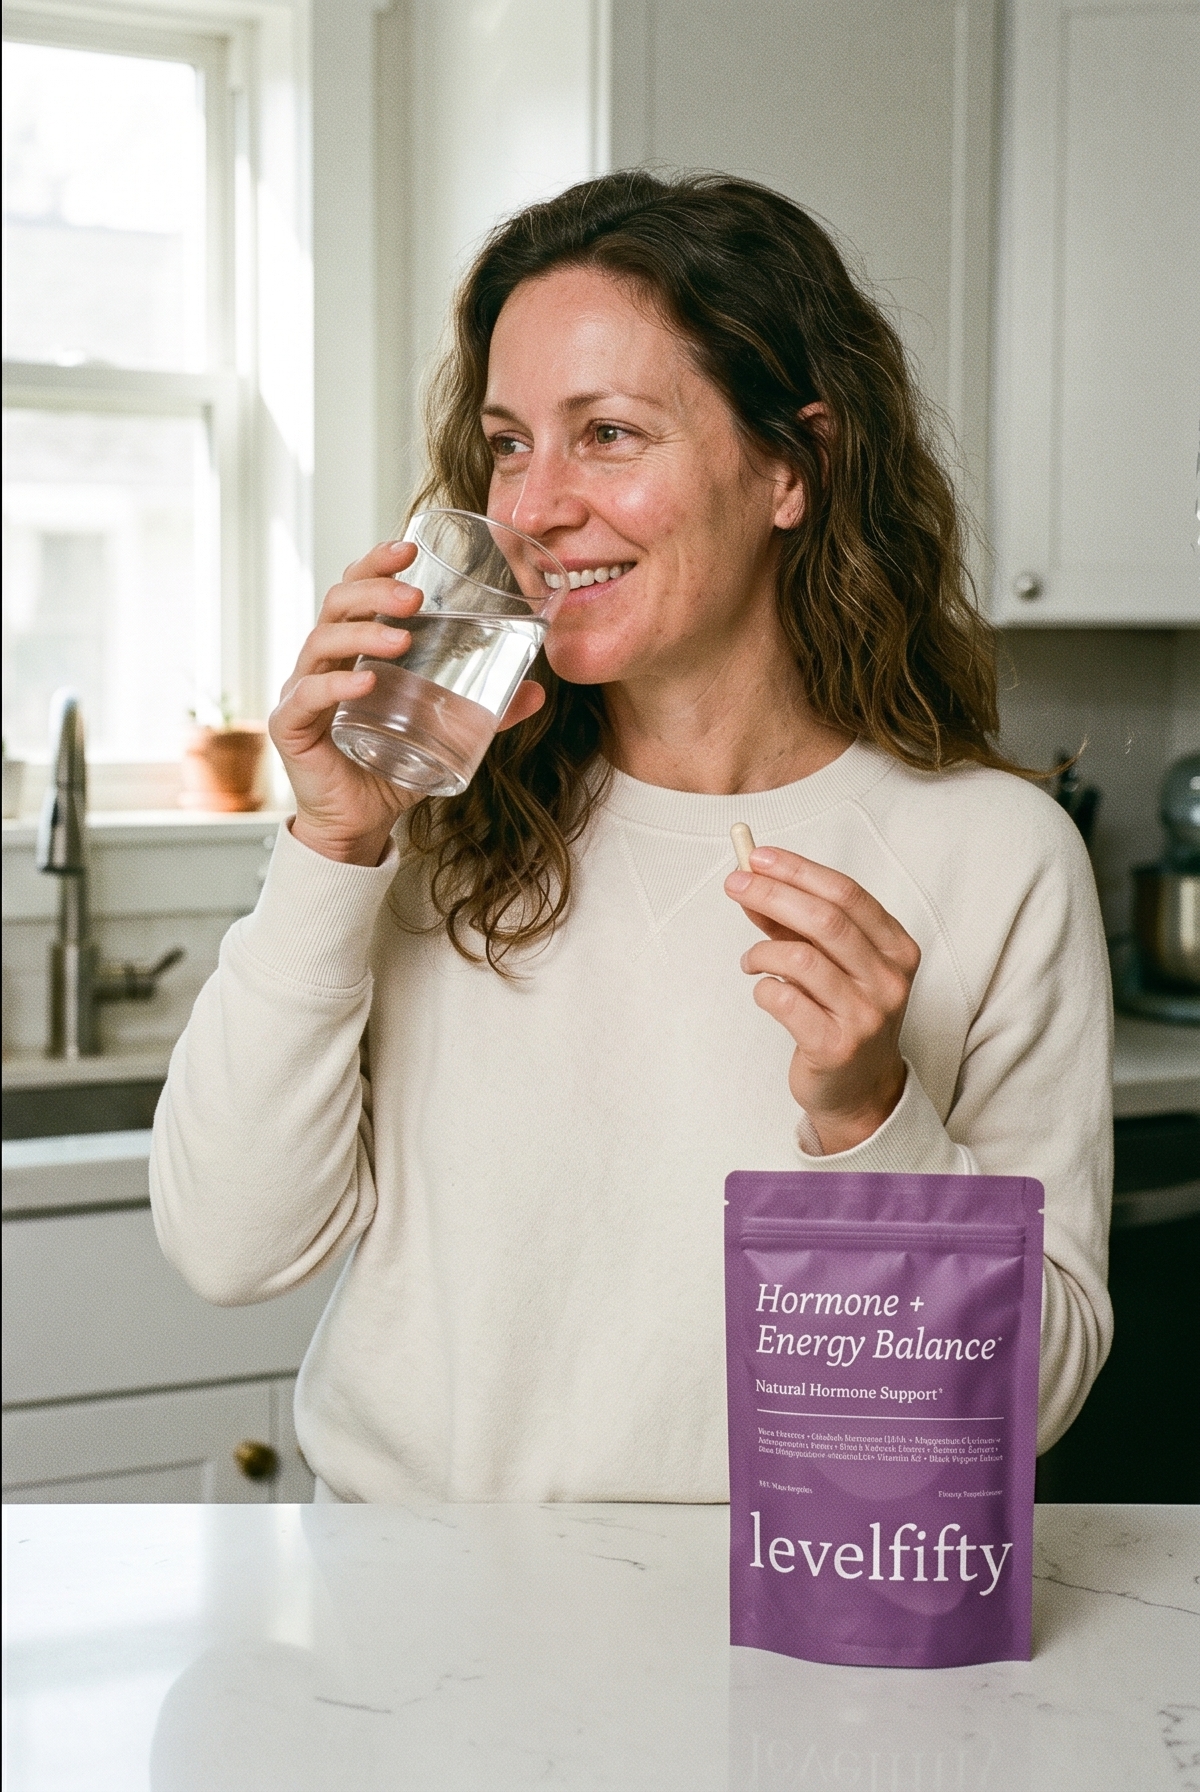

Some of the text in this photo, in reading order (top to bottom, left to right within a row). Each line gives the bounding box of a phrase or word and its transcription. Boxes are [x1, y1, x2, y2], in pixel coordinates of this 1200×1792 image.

[756, 1283, 925, 1317] Hormone +
[756, 1324, 866, 1367] Energy
[756, 1378, 806, 1396] Natural
[809, 1383, 877, 1399] Hormone
[749, 1511, 1014, 1596] levelfifty
